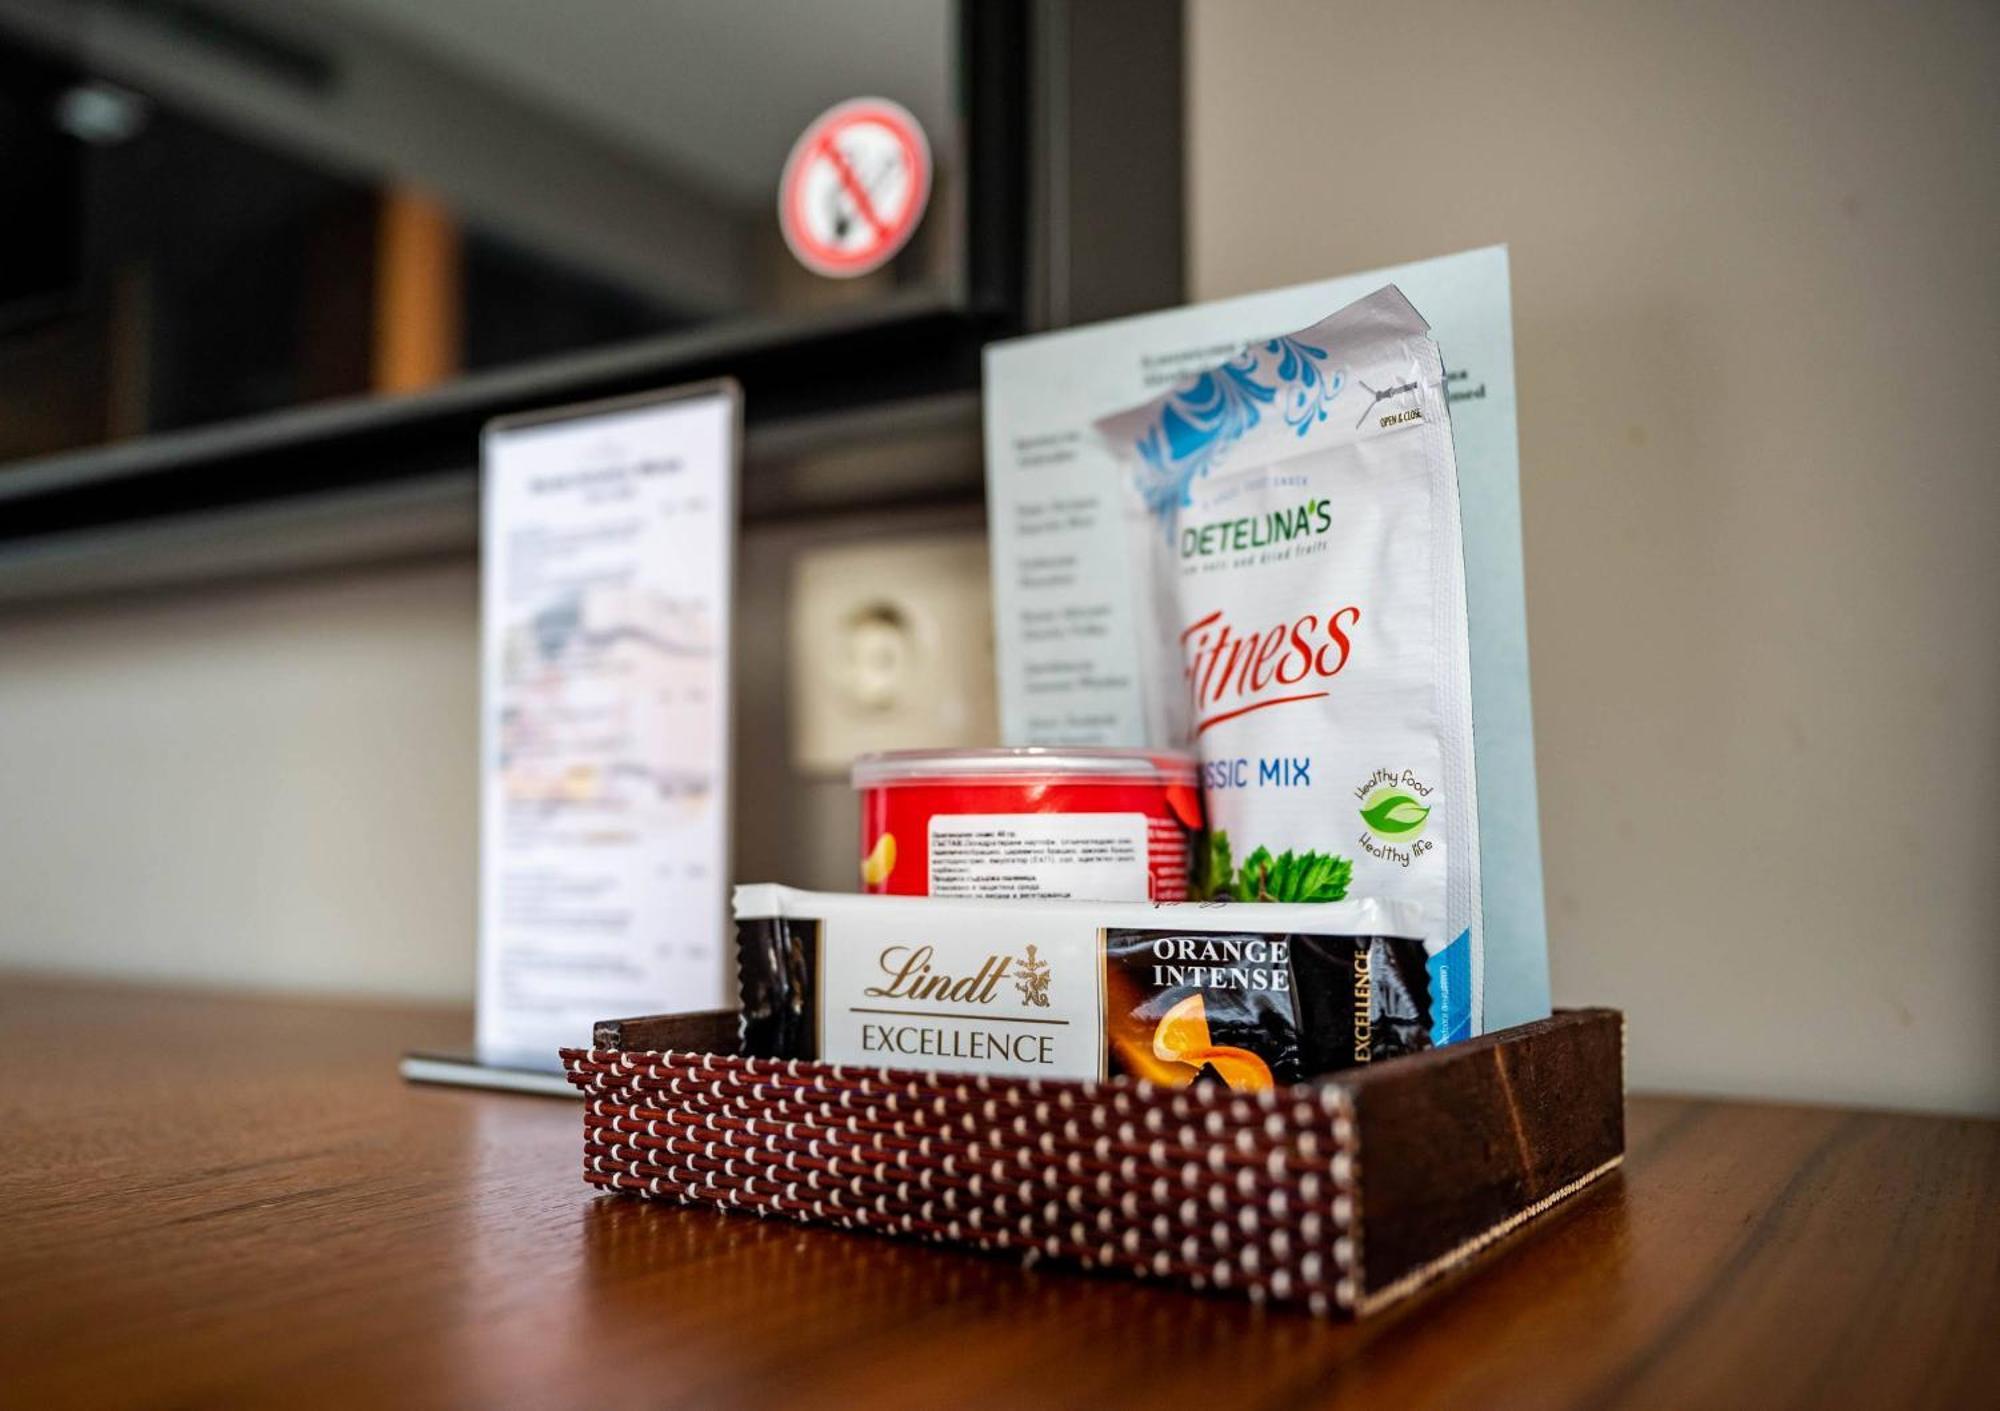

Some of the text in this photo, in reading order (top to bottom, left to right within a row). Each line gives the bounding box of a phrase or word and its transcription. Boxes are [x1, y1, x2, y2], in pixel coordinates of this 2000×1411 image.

[1380, 413, 1397, 428] OPEN
[1181, 499, 1331, 558] DETELINA'S
[1203, 757, 1310, 789] SSIC MIX
[1354, 768, 1398, 801] Healthy
[1359, 831, 1433, 868] Healthy life
[1152, 938, 1290, 964] ORANGE
[864, 945, 1013, 1004] Lindt
[1152, 964, 1290, 992] INTENSE
[1354, 950, 1372, 1062] EXCELLENCE
[862, 1024, 1054, 1064] EXCELLENCE
